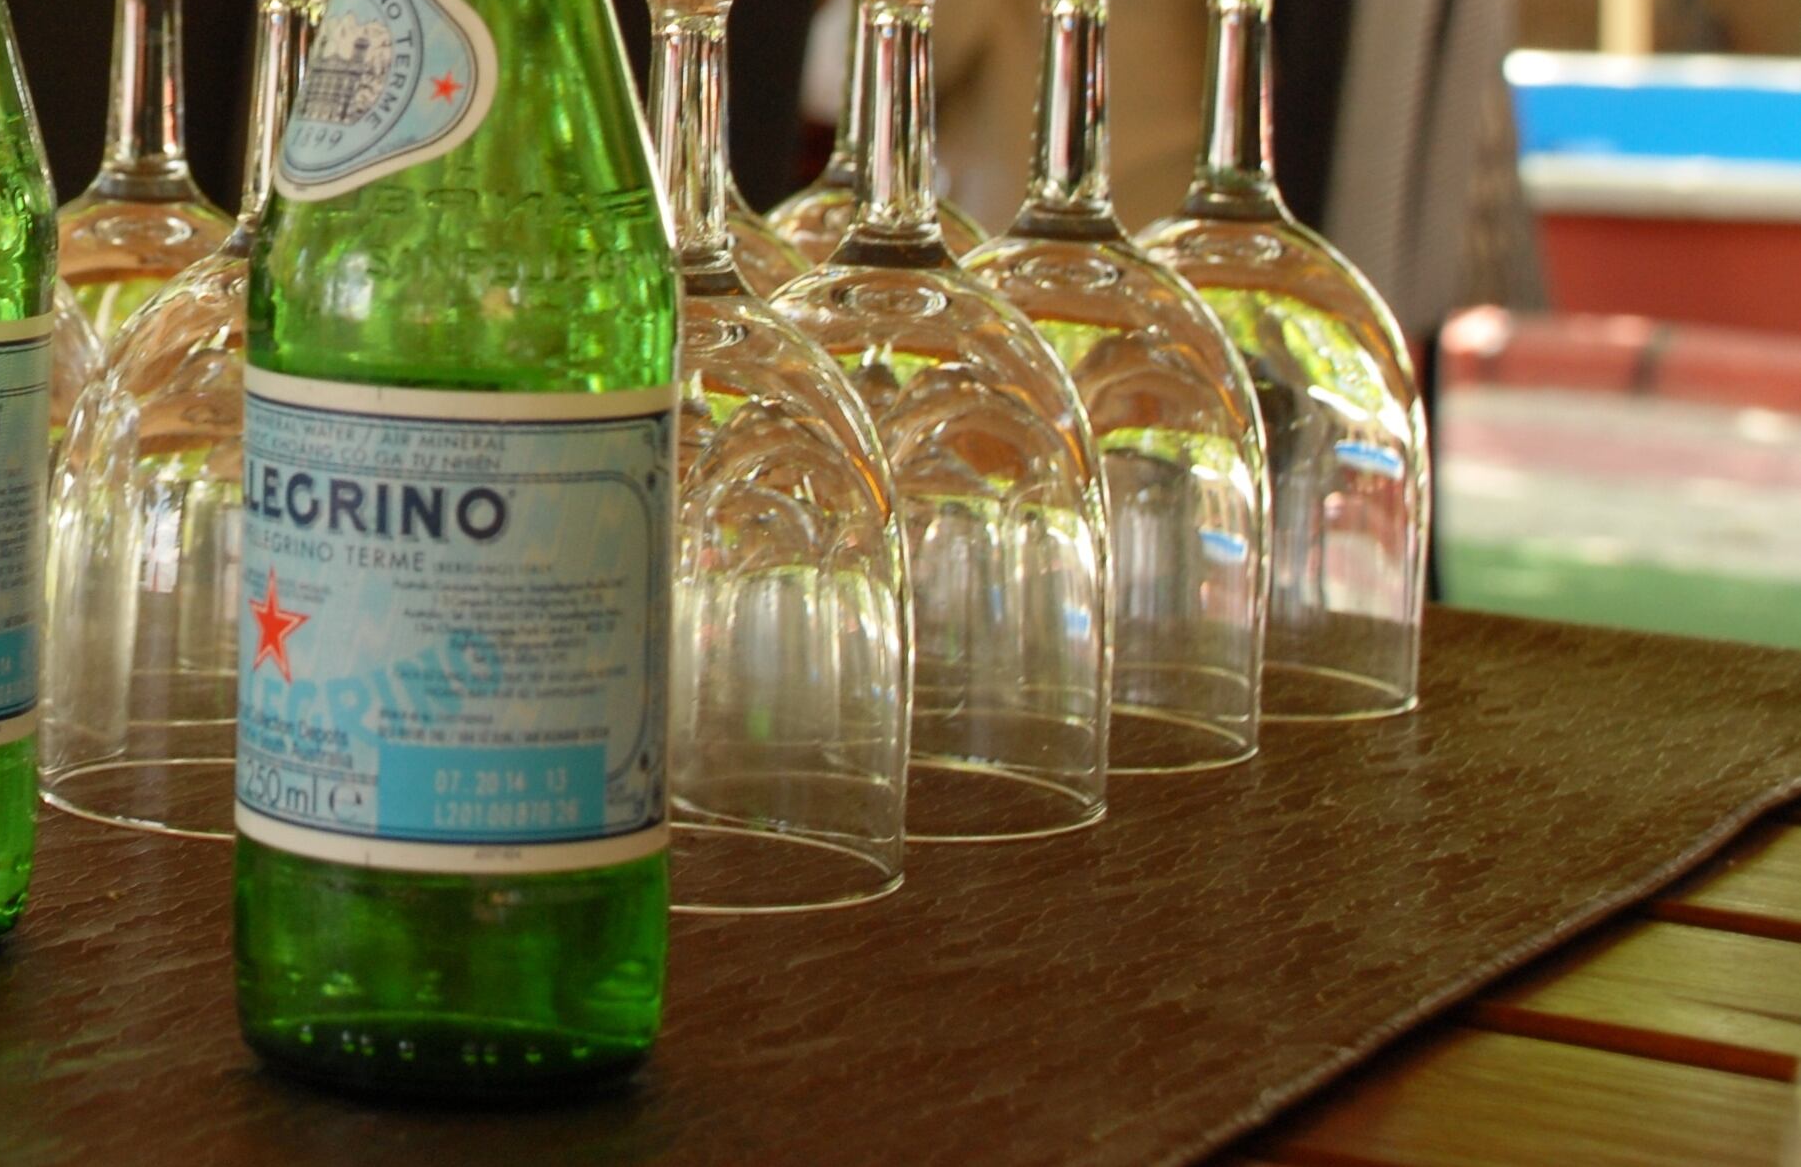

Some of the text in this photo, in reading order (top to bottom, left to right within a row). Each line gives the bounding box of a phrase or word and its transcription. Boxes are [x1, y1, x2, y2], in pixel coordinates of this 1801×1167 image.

[365, 31, 414, 130] TERME
[381, 432, 410, 447] AIR
[418, 433, 506, 451] MINERAL
[244, 460, 508, 541] LEGRINO
[344, 544, 426, 573] TERME
[244, 756, 281, 809] 250
[286, 772, 318, 815] ml
